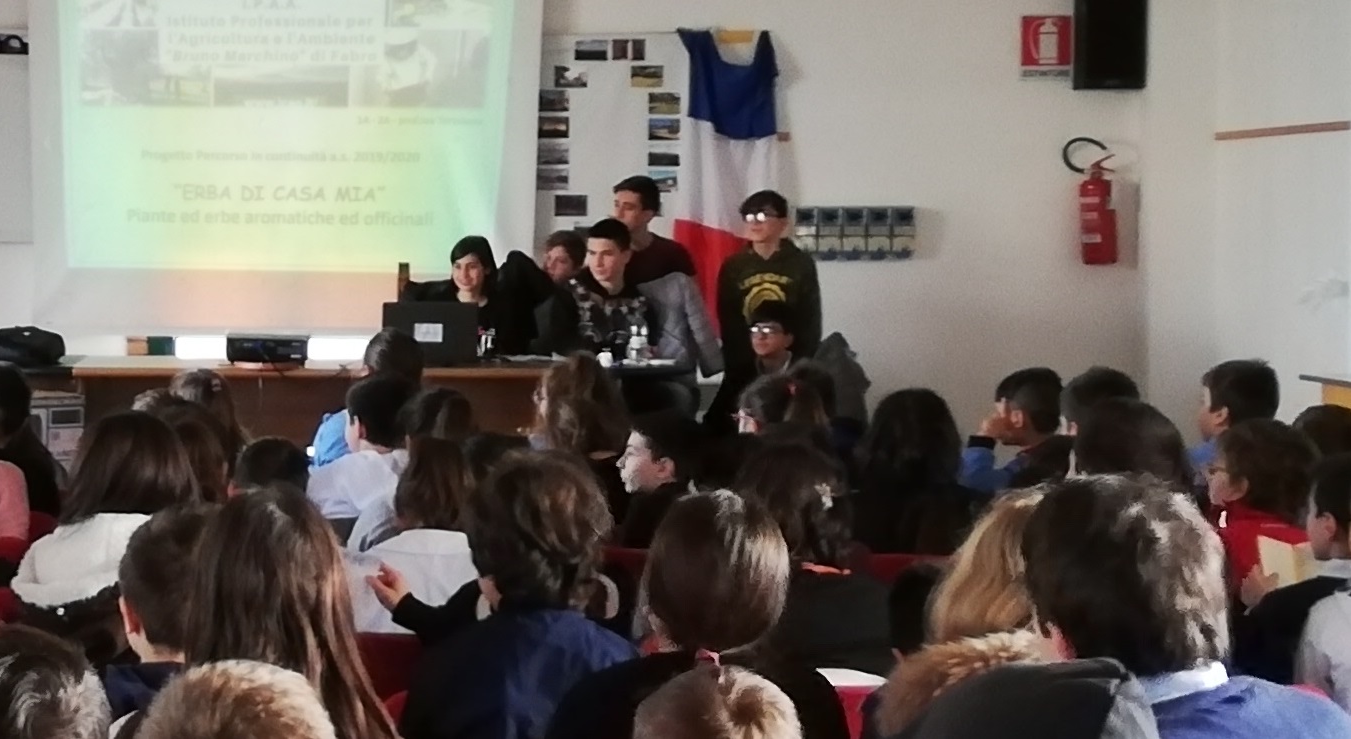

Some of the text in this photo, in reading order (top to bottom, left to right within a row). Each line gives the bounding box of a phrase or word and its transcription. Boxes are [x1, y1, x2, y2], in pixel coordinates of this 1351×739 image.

[167, 14, 374, 30] Istituto Professionale per
[167, 32, 376, 47] l'Agricoltura e l'Ambiente
[309, 48, 326, 62] di
[140, 149, 193, 163] Progetto
[196, 150, 248, 162] Percorso
[352, 151, 421, 163] 2019/2020
[173, 184, 386, 203] "ERBA DI CASA MIA"
[127, 208, 435, 227] Piante ed erbe aromatiche ed officinali
